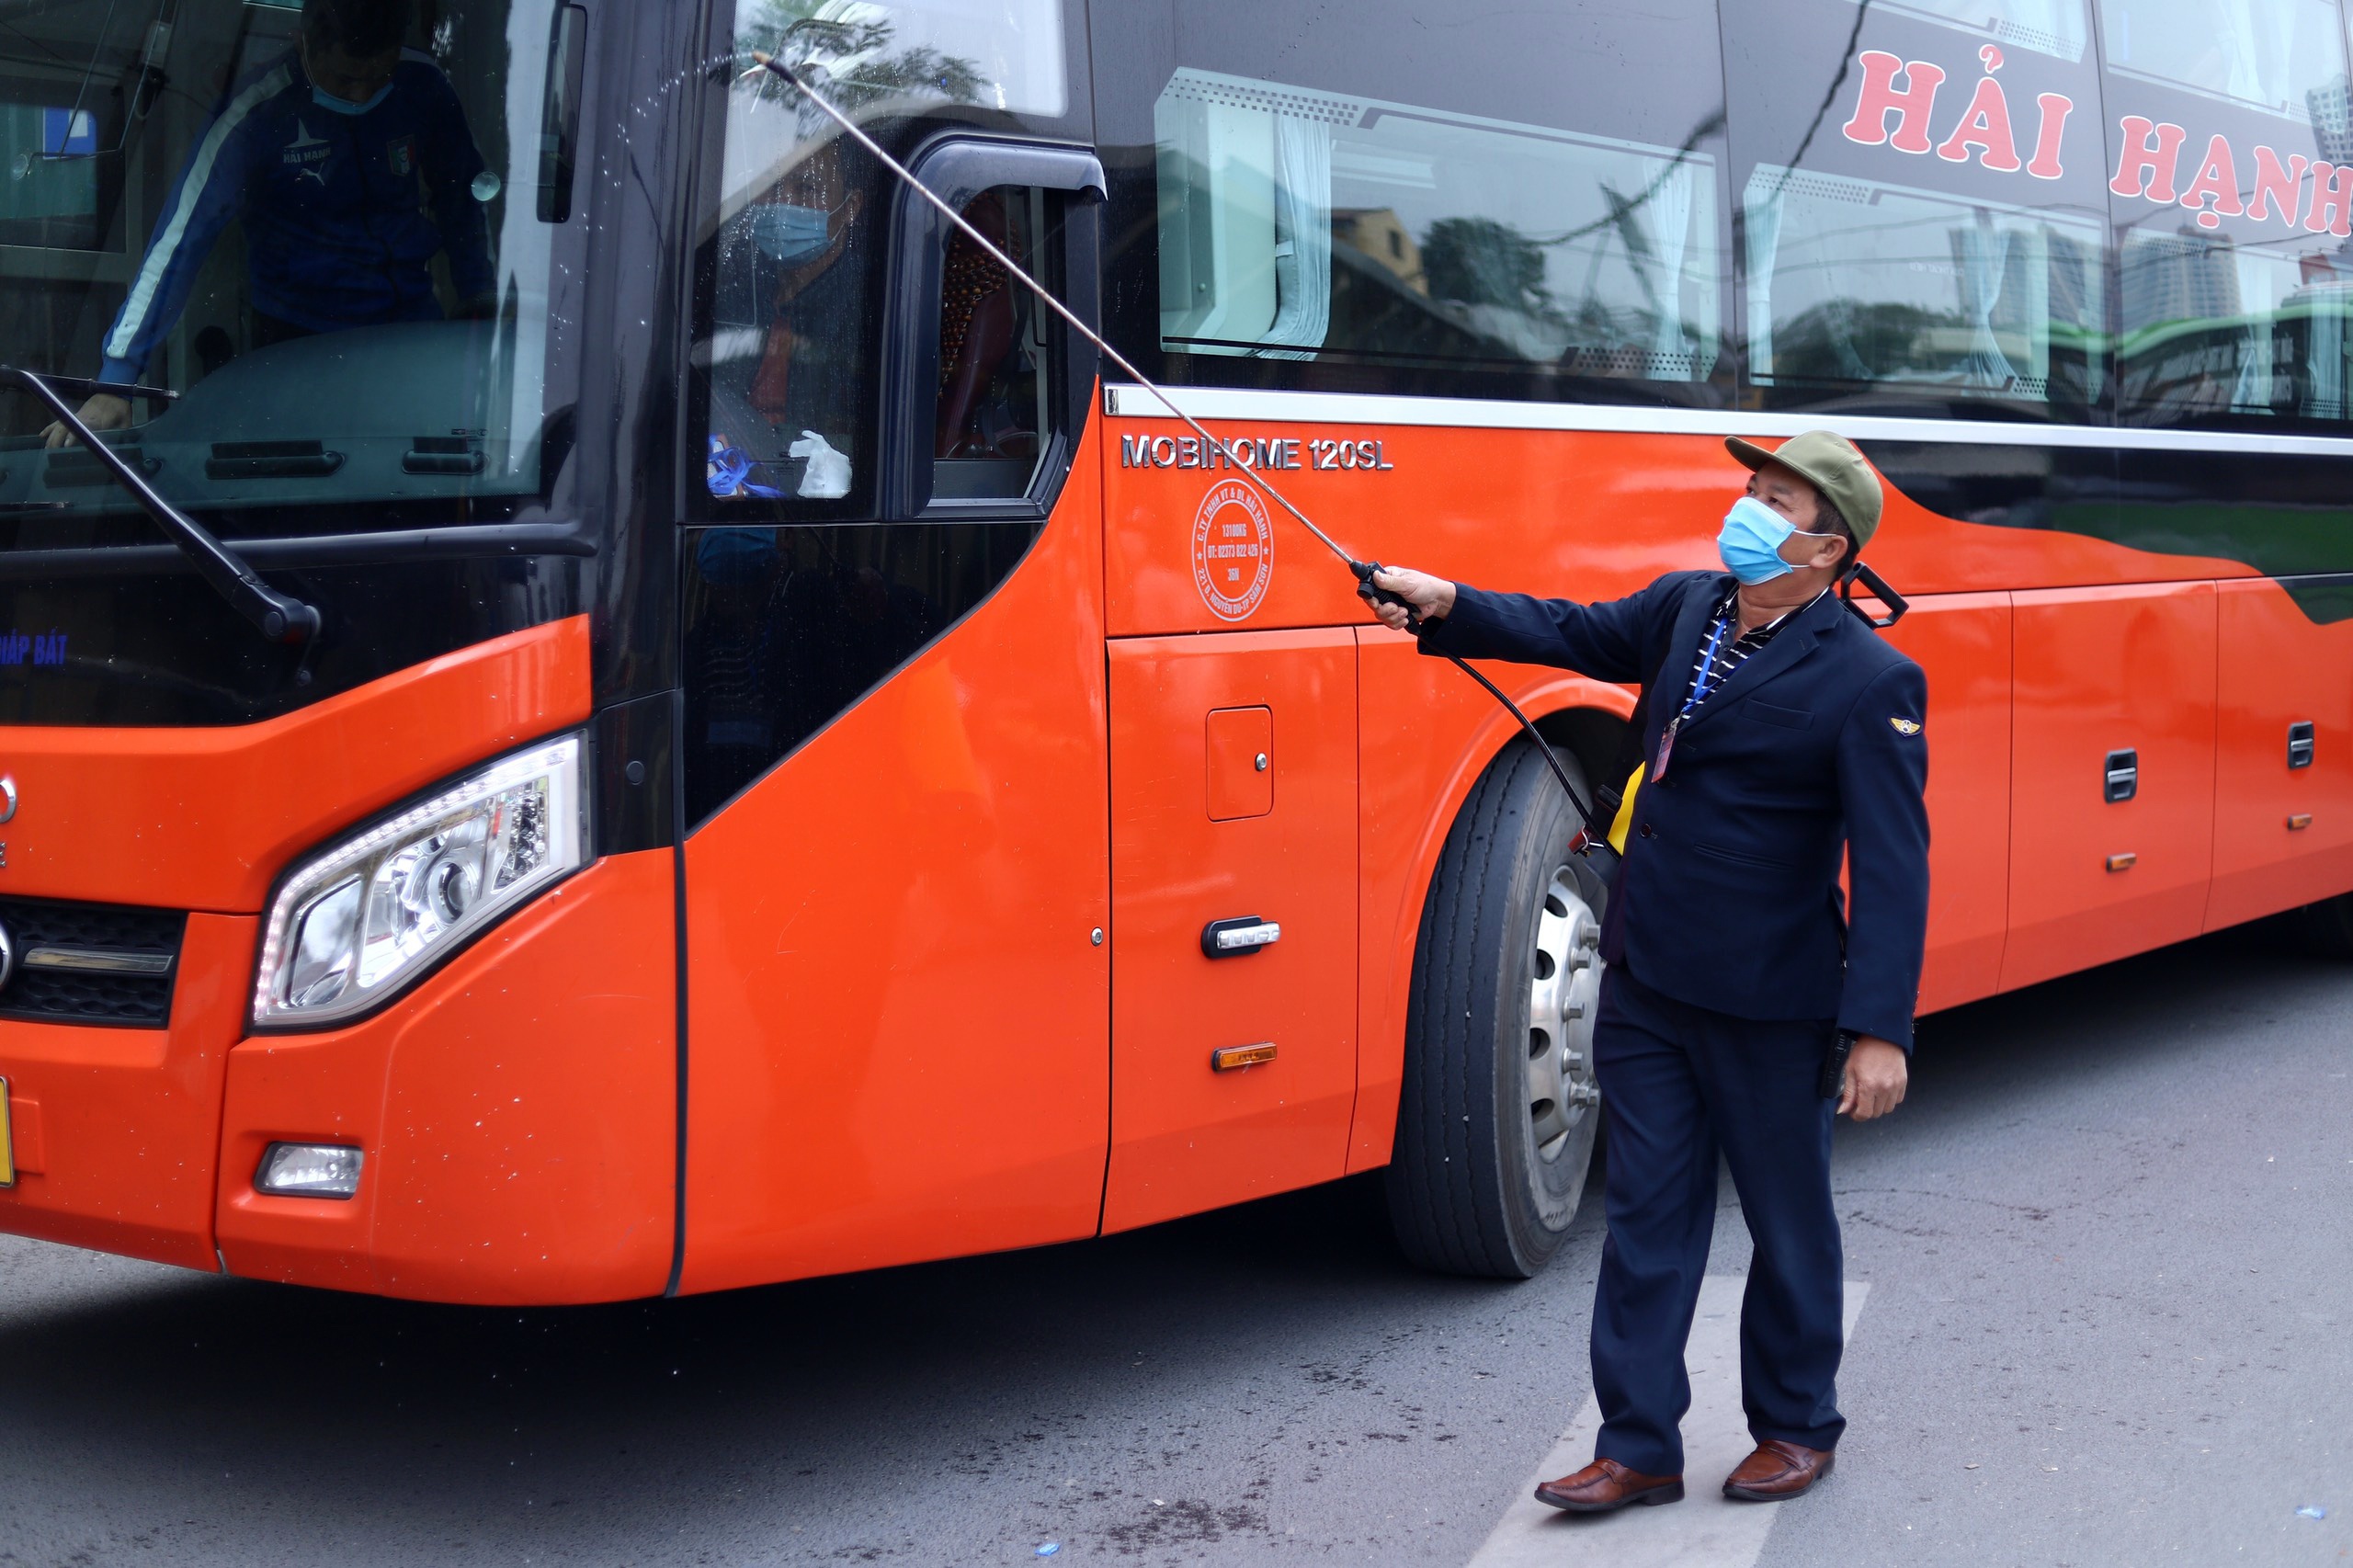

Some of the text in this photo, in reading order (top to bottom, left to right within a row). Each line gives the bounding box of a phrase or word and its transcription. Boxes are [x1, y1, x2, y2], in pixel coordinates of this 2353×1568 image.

[1842, 43, 2353, 238] HẢI HẠNH
[1122, 435, 1393, 471] MOBIHOME 120SL
[1203, 494, 1221, 518] TNHH
[1220, 487, 1229, 501] VT
[1230, 487, 1235, 498] &
[34, 628, 67, 665] BÁT
